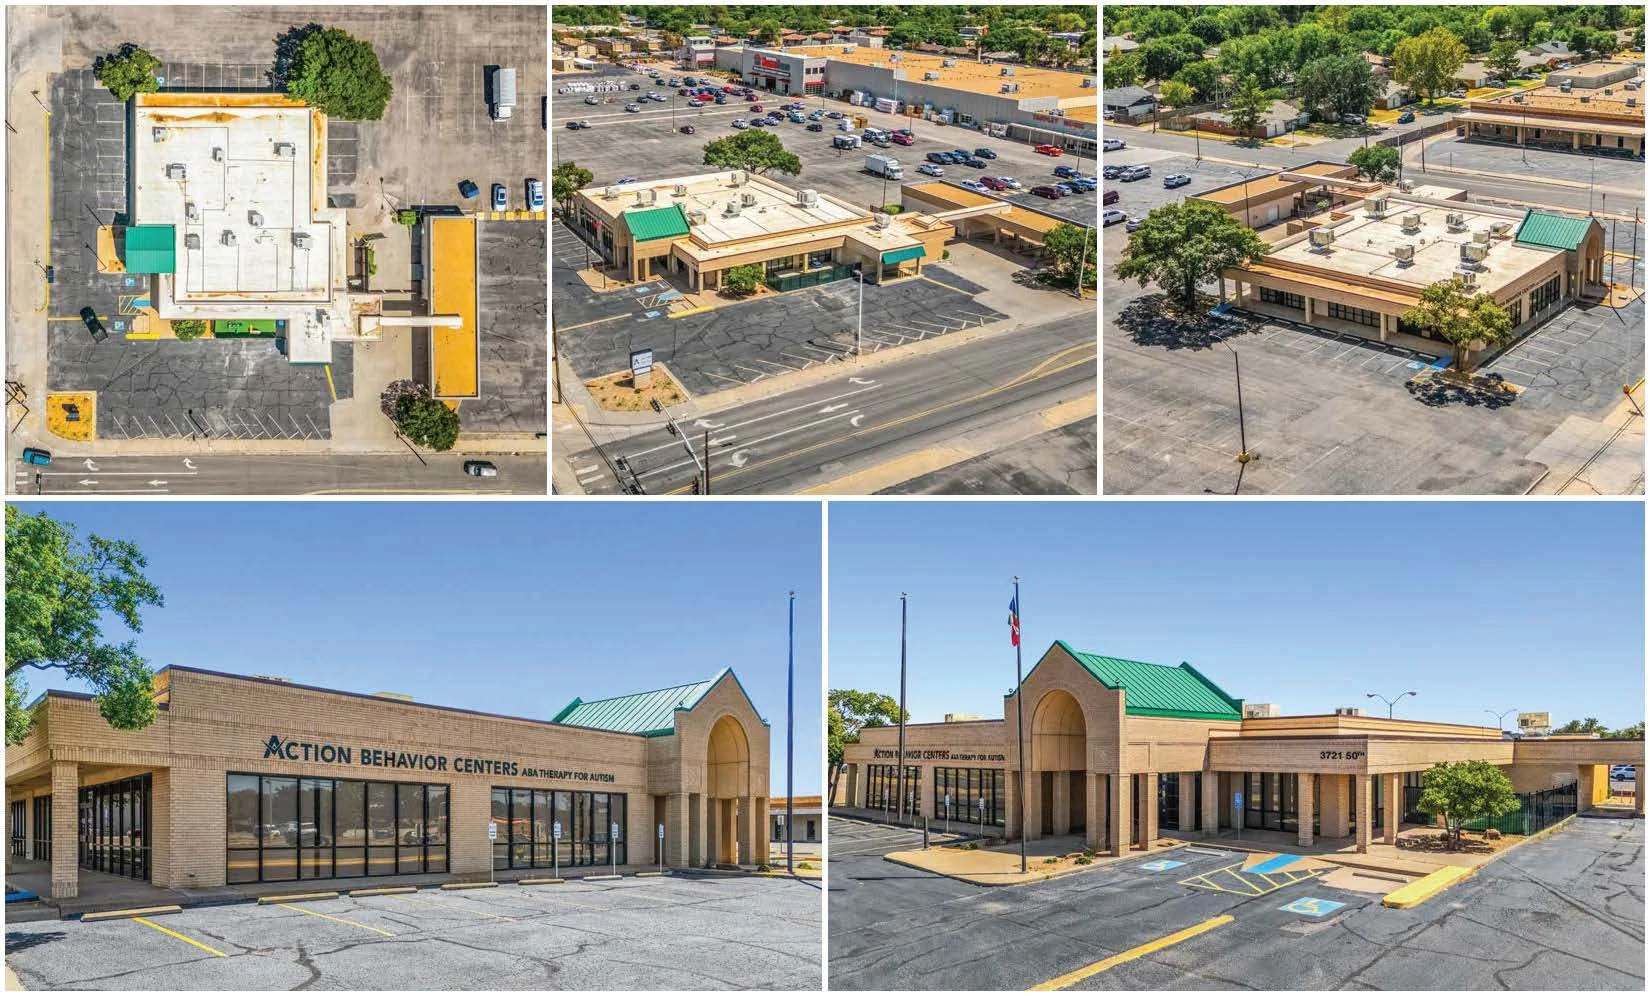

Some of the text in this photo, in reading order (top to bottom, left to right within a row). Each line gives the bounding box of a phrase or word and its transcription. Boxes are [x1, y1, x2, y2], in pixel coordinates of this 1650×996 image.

[261, 735, 615, 783] ACTION BEHAVIOR CENTERS ABA THERAPY FOR AUTISM
[873, 747, 894, 759] ACTION
[922, 750, 950, 760] CENTERS
[1320, 751, 1342, 760] 3721
